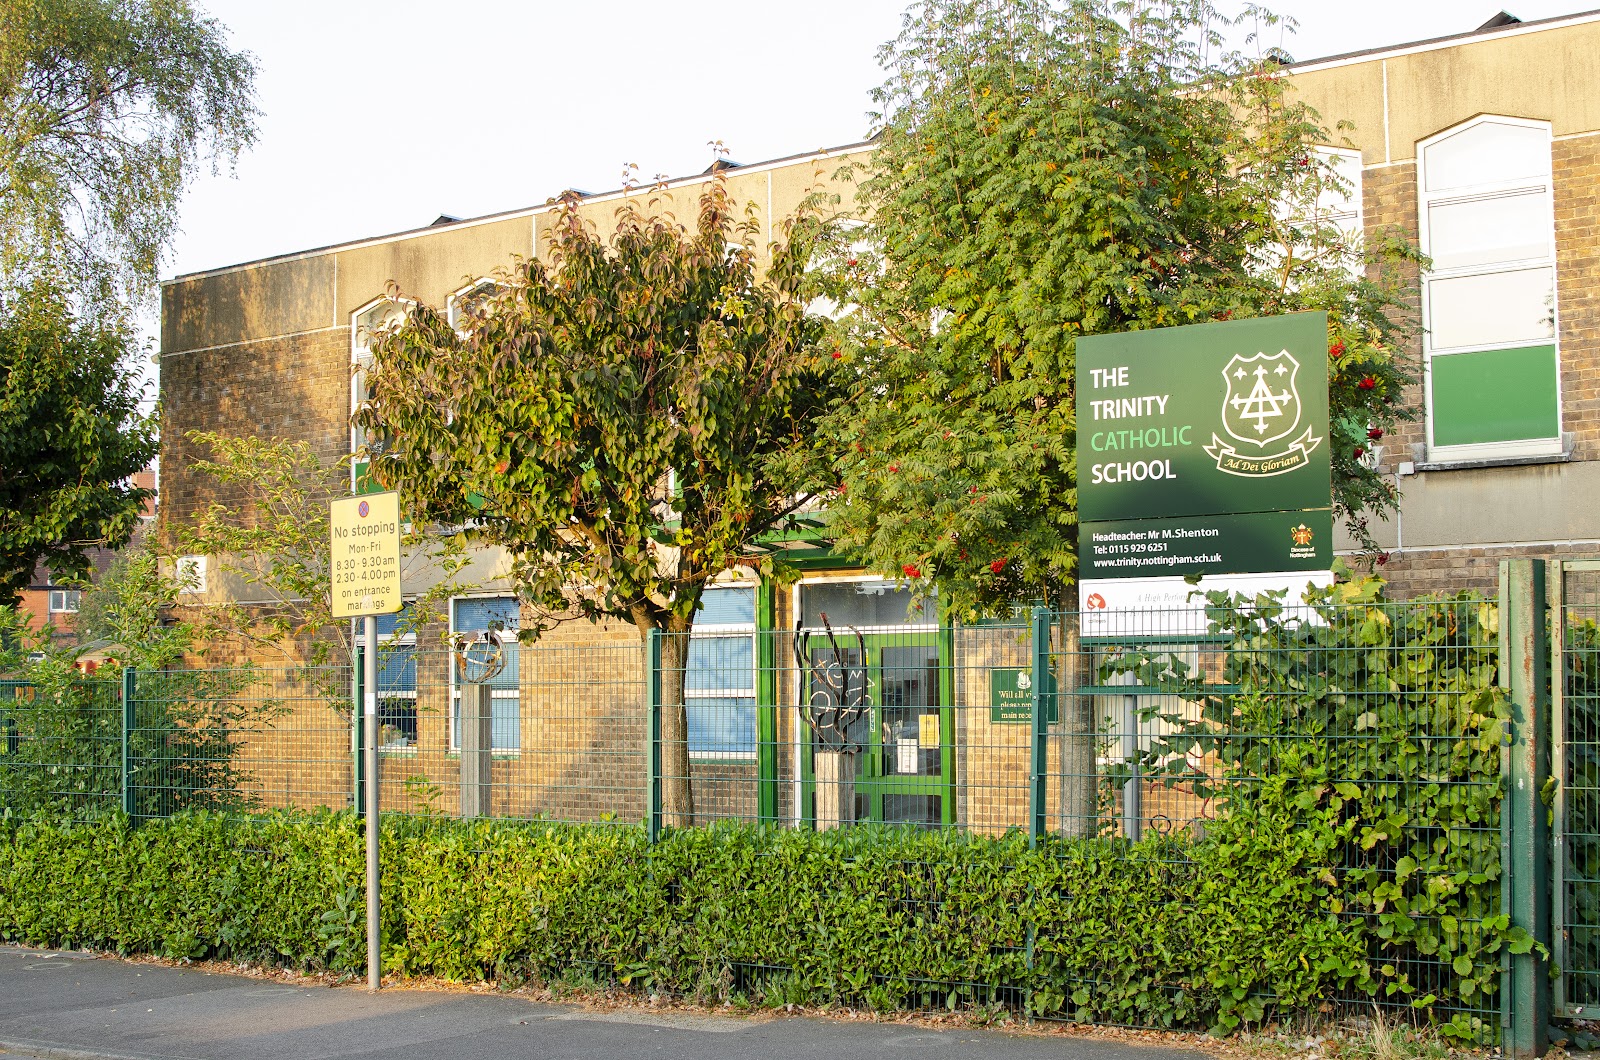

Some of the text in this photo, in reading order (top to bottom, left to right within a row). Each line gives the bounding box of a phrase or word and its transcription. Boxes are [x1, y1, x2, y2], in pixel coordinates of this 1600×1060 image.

[1090, 367, 1129, 389] THE
[1090, 395, 1169, 420] TRINITY
[1091, 425, 1192, 451] CATHOLIC
[1091, 459, 1176, 484] SCHOOL
[1224, 455, 1300, 473] Ad Dei Gloriam
[335, 521, 395, 538] No stopping
[1092, 528, 1219, 542] Headteacher: Mr M.Shenton
[1093, 543, 1168, 554] Tel: 0115 929 6251
[1094, 553, 1222, 568] www.trinity.nottingham.sch.uk
[342, 585, 390, 598] on entrance
